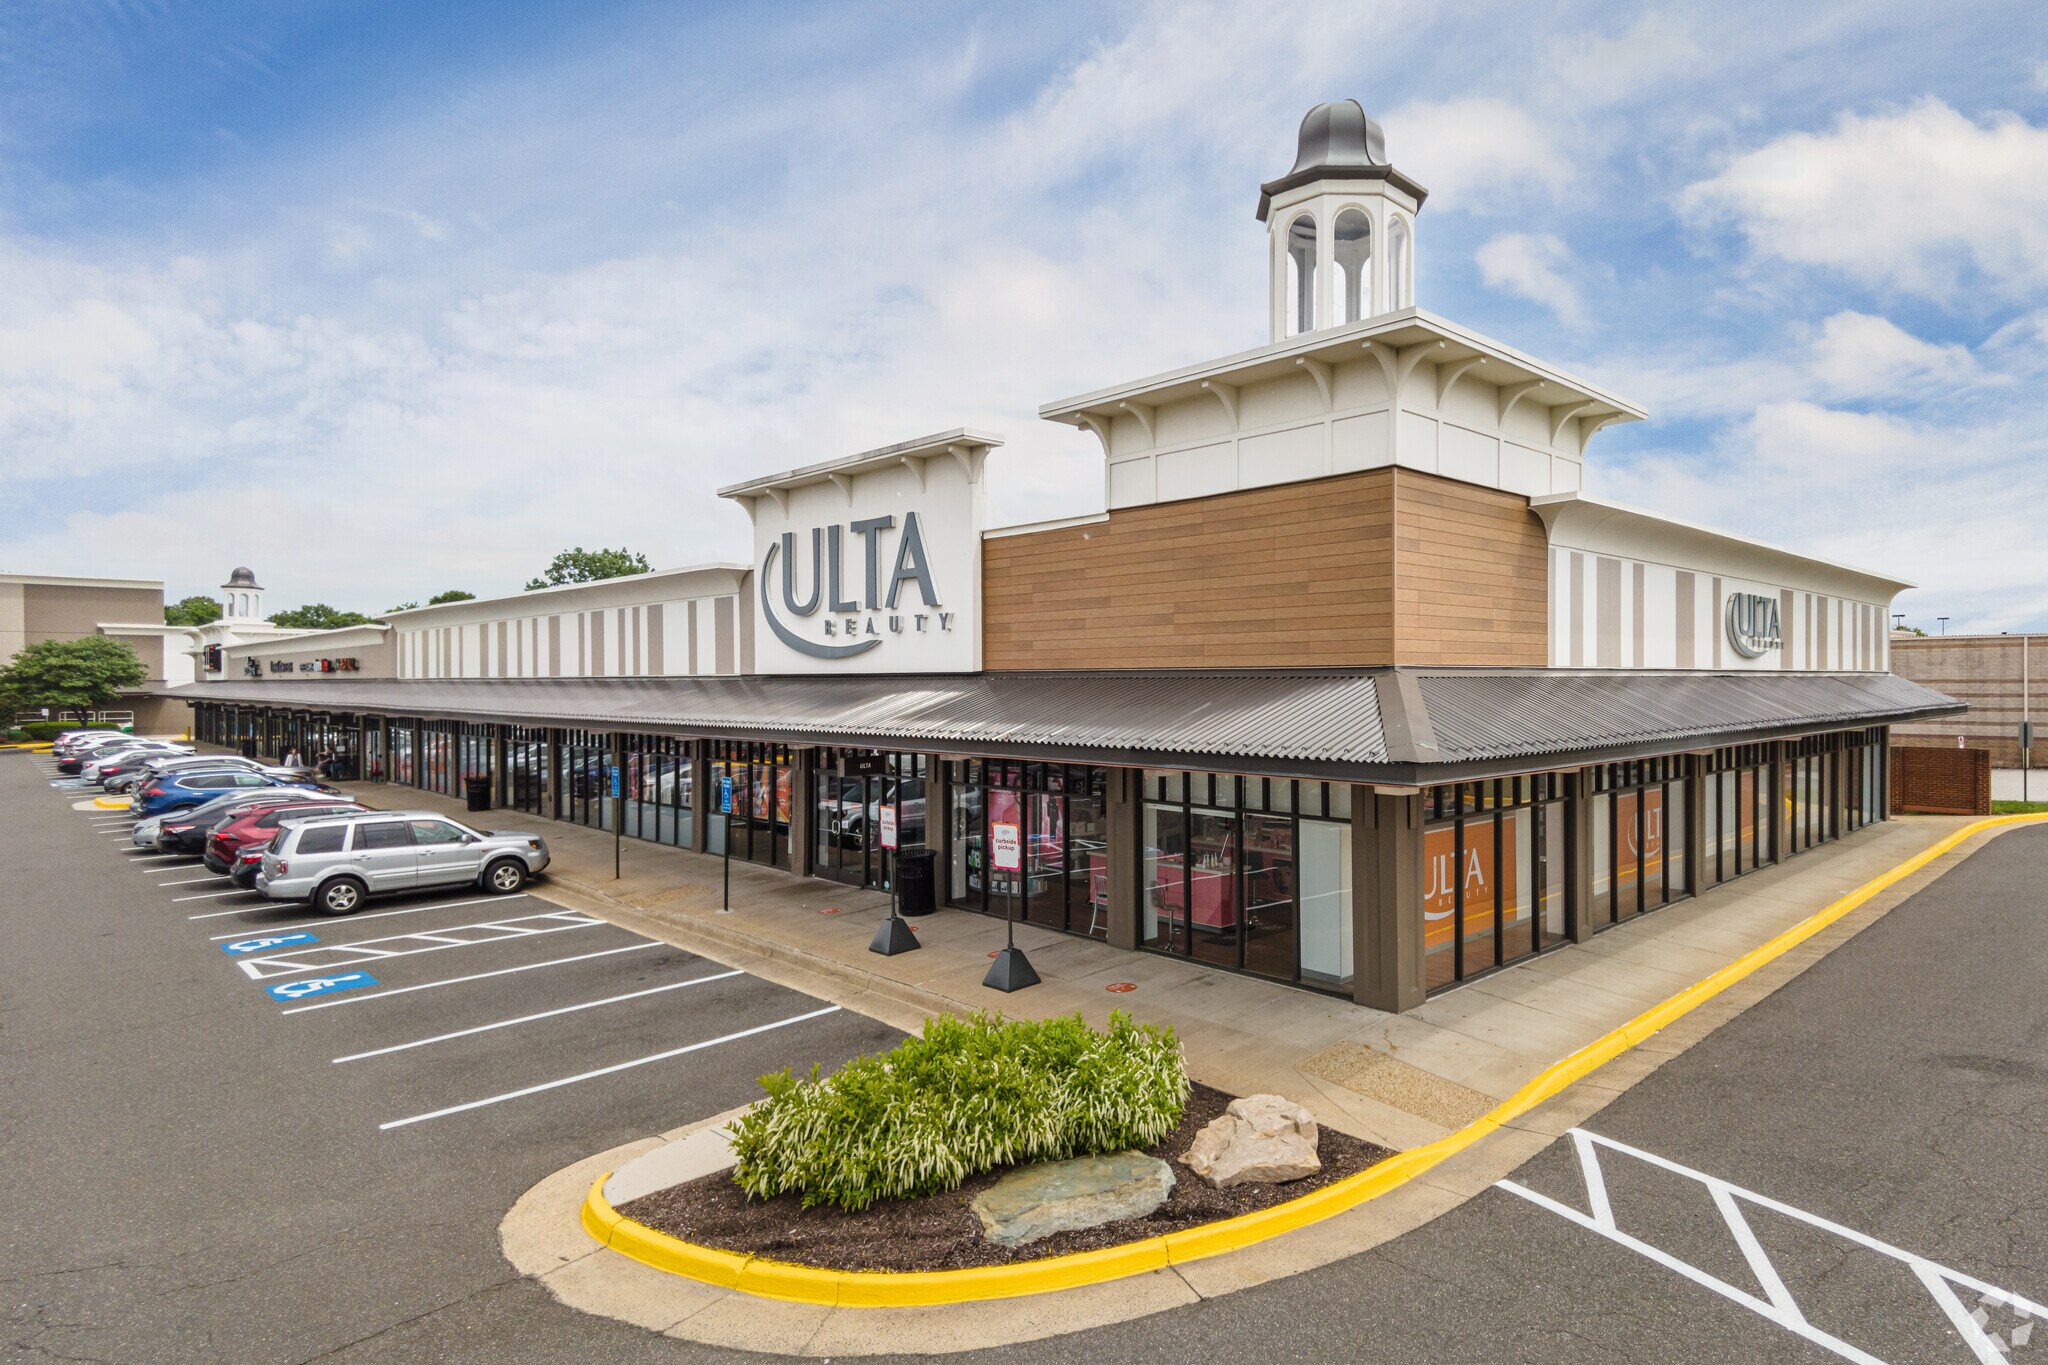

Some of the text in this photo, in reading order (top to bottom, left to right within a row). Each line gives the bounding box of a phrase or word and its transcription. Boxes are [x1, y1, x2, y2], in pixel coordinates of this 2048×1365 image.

[782, 511, 942, 617] ULTA
[824, 613, 954, 636] BEAUTY
[1737, 592, 1780, 638] ULTA
[1438, 886, 1489, 907] BEUTY
